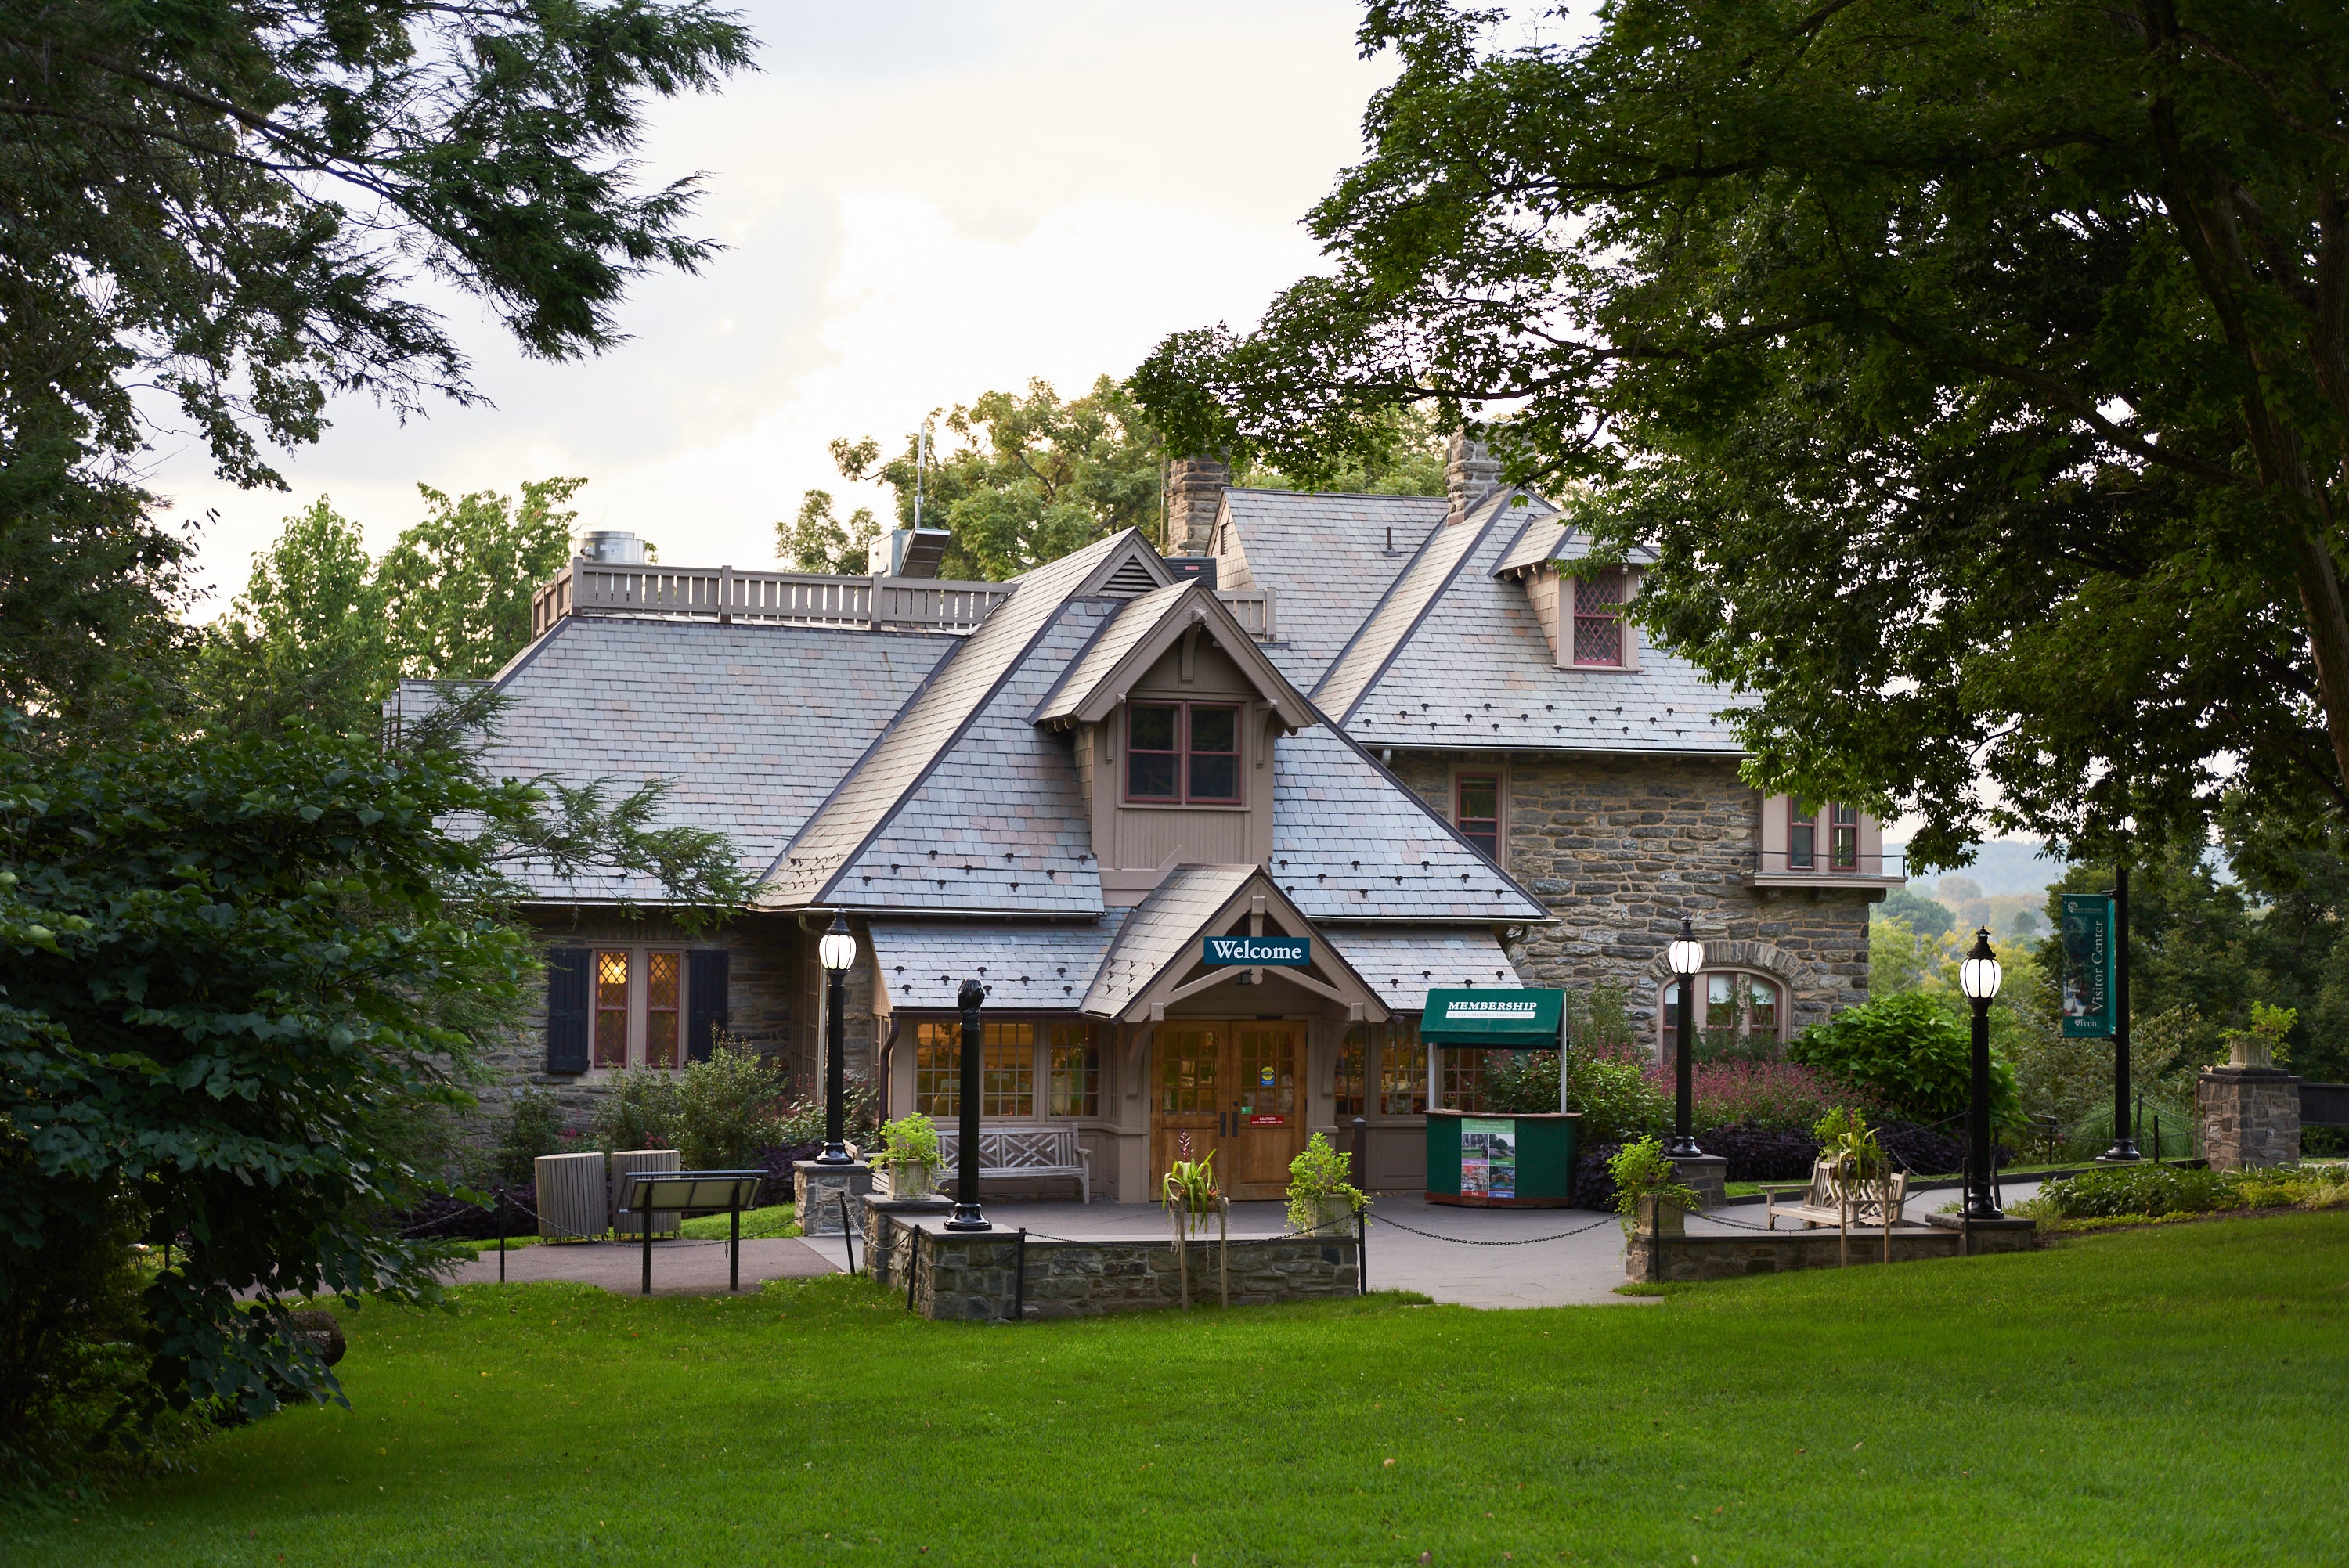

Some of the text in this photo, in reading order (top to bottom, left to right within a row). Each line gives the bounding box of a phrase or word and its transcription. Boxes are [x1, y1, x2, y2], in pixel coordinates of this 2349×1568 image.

[1211, 939, 1301, 960] Welcome
[2091, 921, 2104, 1012] Visitor Center
[1447, 1001, 1538, 1011] MEMBERSHIP
